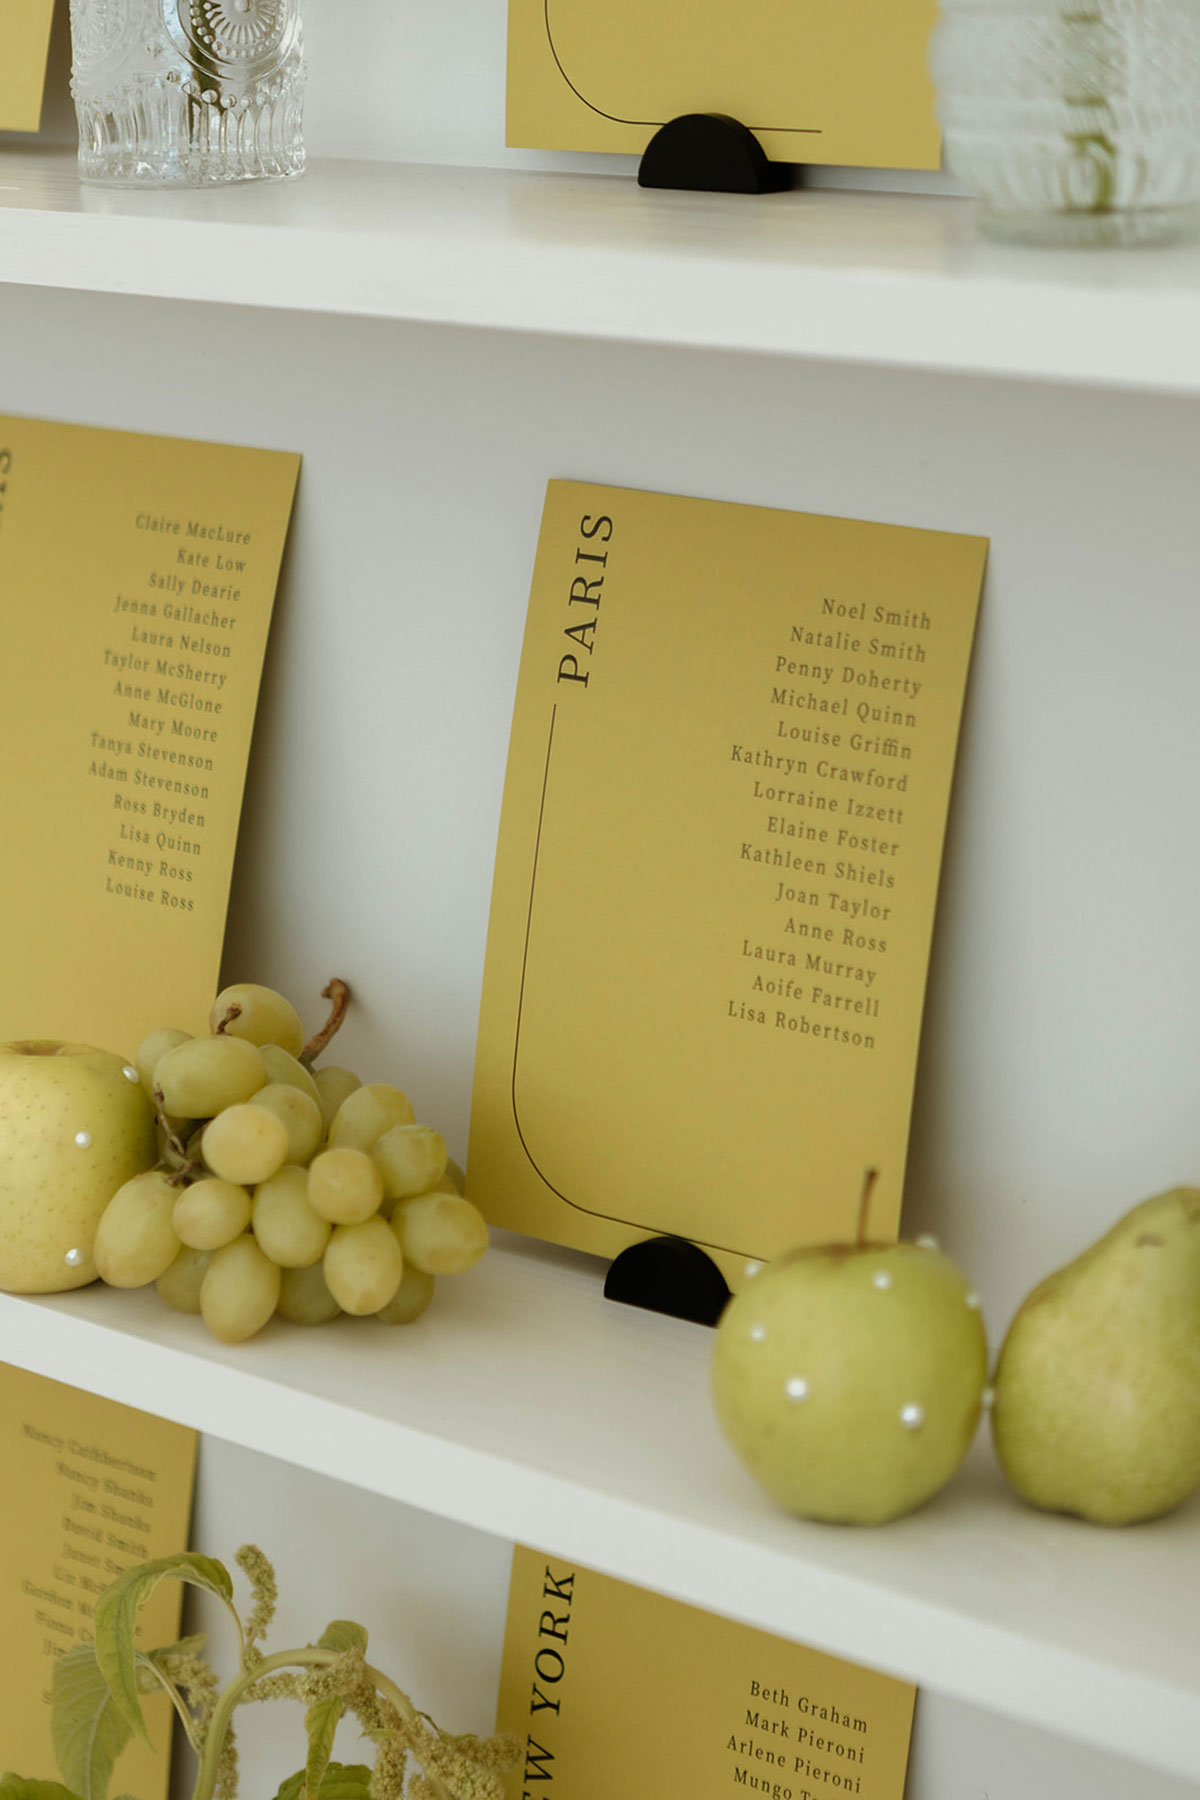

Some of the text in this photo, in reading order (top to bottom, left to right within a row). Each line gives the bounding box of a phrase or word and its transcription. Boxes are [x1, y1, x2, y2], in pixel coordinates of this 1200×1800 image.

[136, 514, 250, 545] Claire MacLure
[177, 549, 246, 572] Kate Low
[149, 573, 240, 601] Sally Dearie
[556, 514, 613, 688] PARIS
[114, 594, 236, 630] Jenna Gallacher
[822, 598, 930, 630] Noel Smith
[132, 626, 230, 657] Laura Nelson
[790, 626, 925, 662] Natalie Smith
[104, 649, 226, 690] Taylor McSherry
[776, 656, 922, 699] Penny Doherty
[114, 680, 222, 714] Anne McGlone
[771, 687, 915, 727] Michael Quinn
[129, 712, 217, 742] Mary Moore
[778, 721, 911, 759] Louise Griffin
[92, 732, 213, 771] Tanya Stevenson
[731, 745, 908, 792] Kathryn Crawford
[88, 761, 208, 799] Adam Stevenson
[114, 794, 204, 827] Ross Bryden
[753, 781, 903, 824] Lorraine Izzett
[120, 823, 200, 855] Lisa Quinn
[767, 816, 899, 856] Elaine Foster
[108, 849, 192, 882] Kenny Ross
[741, 843, 894, 888] Kathleen Shiels
[106, 877, 194, 911] Louise Ross
[775, 883, 891, 920] Joan Taylor
[784, 918, 886, 952] Anne Ross
[743, 940, 876, 987] Laura Murray
[753, 975, 879, 1017] Aoife Farrell
[728, 1000, 874, 1049] Lisa Robertson
[529, 1565, 576, 1716] YORK
[751, 1680, 866, 1733] Beth Graham
[746, 1710, 864, 1763] Mark Pieroni
[727, 1736, 860, 1793] Arlene Pieroni
[734, 1767, 792, 1800] Mungo
